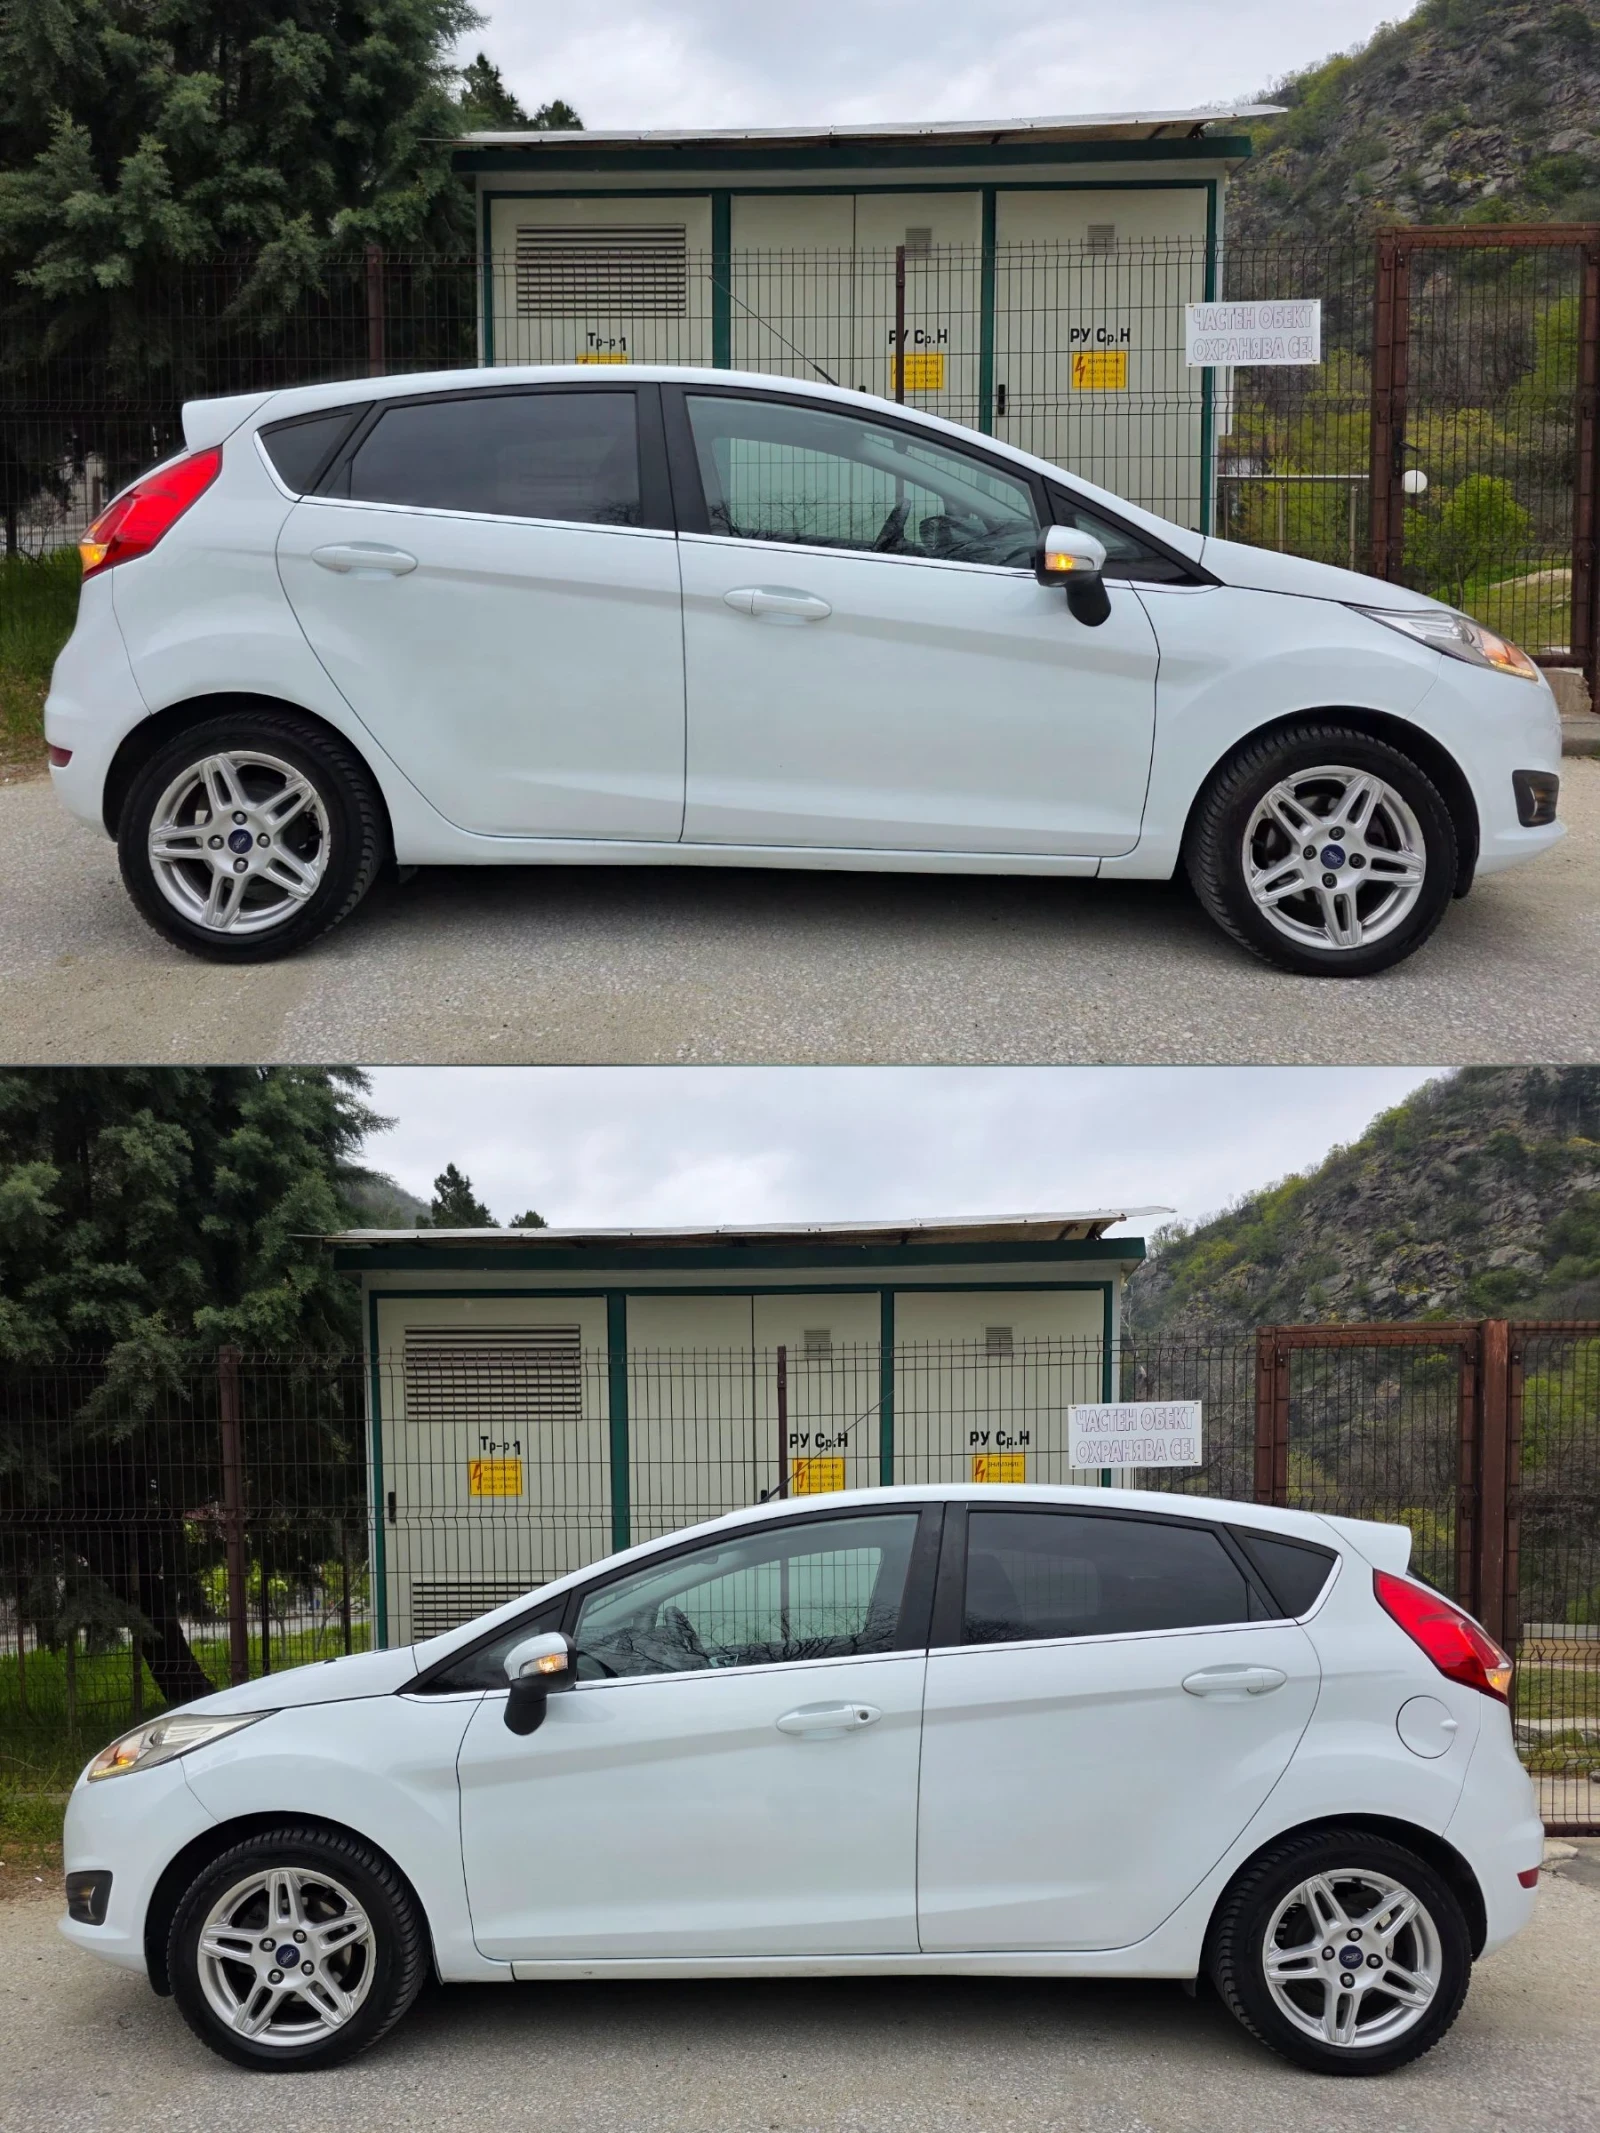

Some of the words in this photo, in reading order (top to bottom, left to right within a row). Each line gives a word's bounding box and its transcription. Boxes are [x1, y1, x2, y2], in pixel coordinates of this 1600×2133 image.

[1193, 307, 1255, 331] ЧАСТЕН
[1259, 306, 1313, 329] ОБЕКТ
[1070, 328, 1091, 343] РУ
[619, 337, 626, 351] 1
[1193, 337, 1285, 361] ОХРАНЯВА
[1288, 336, 1313, 359] СЕ!
[1075, 1408, 1137, 1432] ЧАСТЕН
[1141, 1407, 1194, 1431] ОБЕКТ
[789, 1433, 809, 1448] РУ
[970, 1431, 991, 1446] РУ
[513, 1440, 521, 1455] 1
[1076, 1439, 1167, 1463] ОХРАНЯВА
[1170, 1438, 1195, 1460] СЕ!
